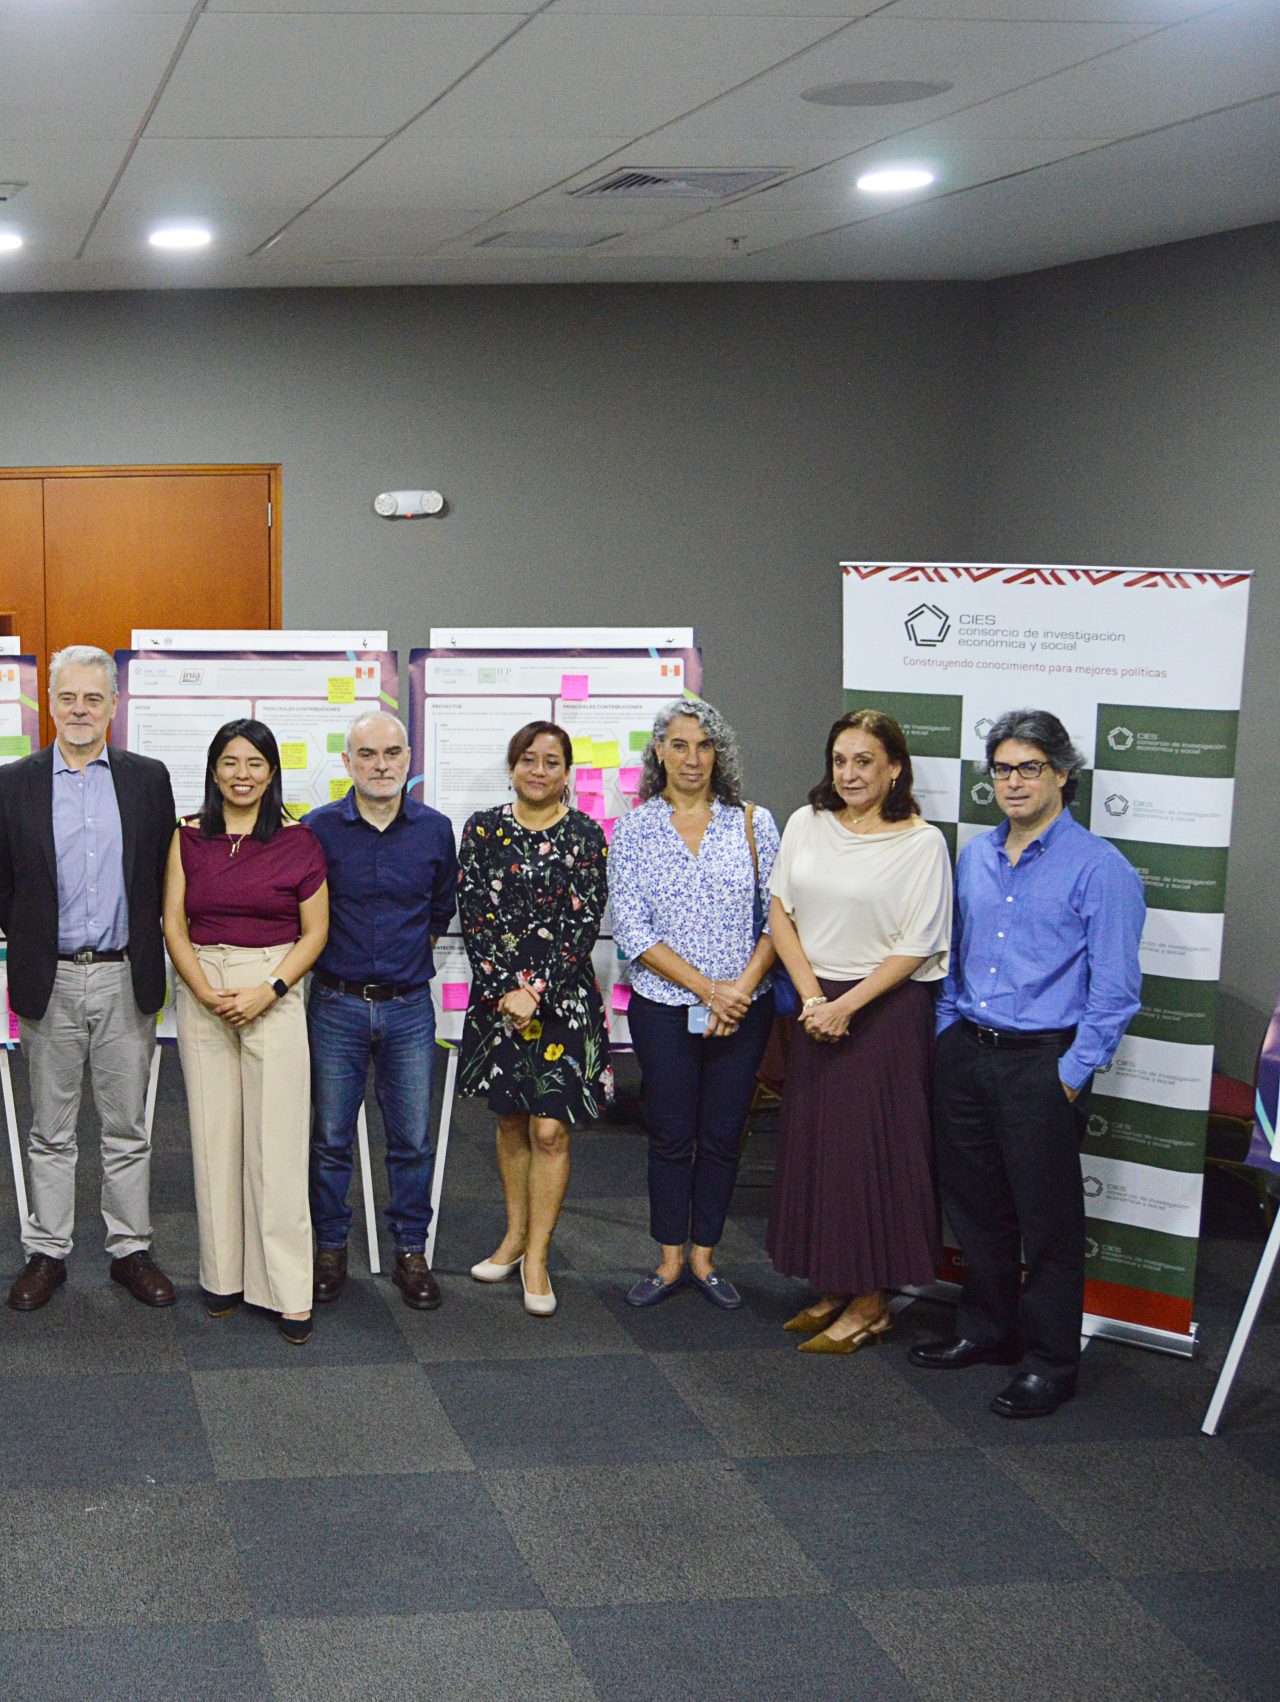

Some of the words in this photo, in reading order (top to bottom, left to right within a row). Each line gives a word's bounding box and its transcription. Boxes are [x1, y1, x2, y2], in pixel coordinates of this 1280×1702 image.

[959, 614, 996, 626] CIES
[958, 627, 1020, 639] consorcio
[1024, 628, 1039, 639] de
[1043, 630, 1126, 643] investigación
[958, 637, 1026, 649] económica
[1029, 642, 1037, 651] y
[1041, 641, 1077, 651] social
[902, 656, 974, 670] Construyendo
[976, 660, 1046, 673] conocimiento
[1048, 664, 1073, 675] para
[1075, 664, 1119, 677] mejores
[1120, 667, 1168, 679] políticas
